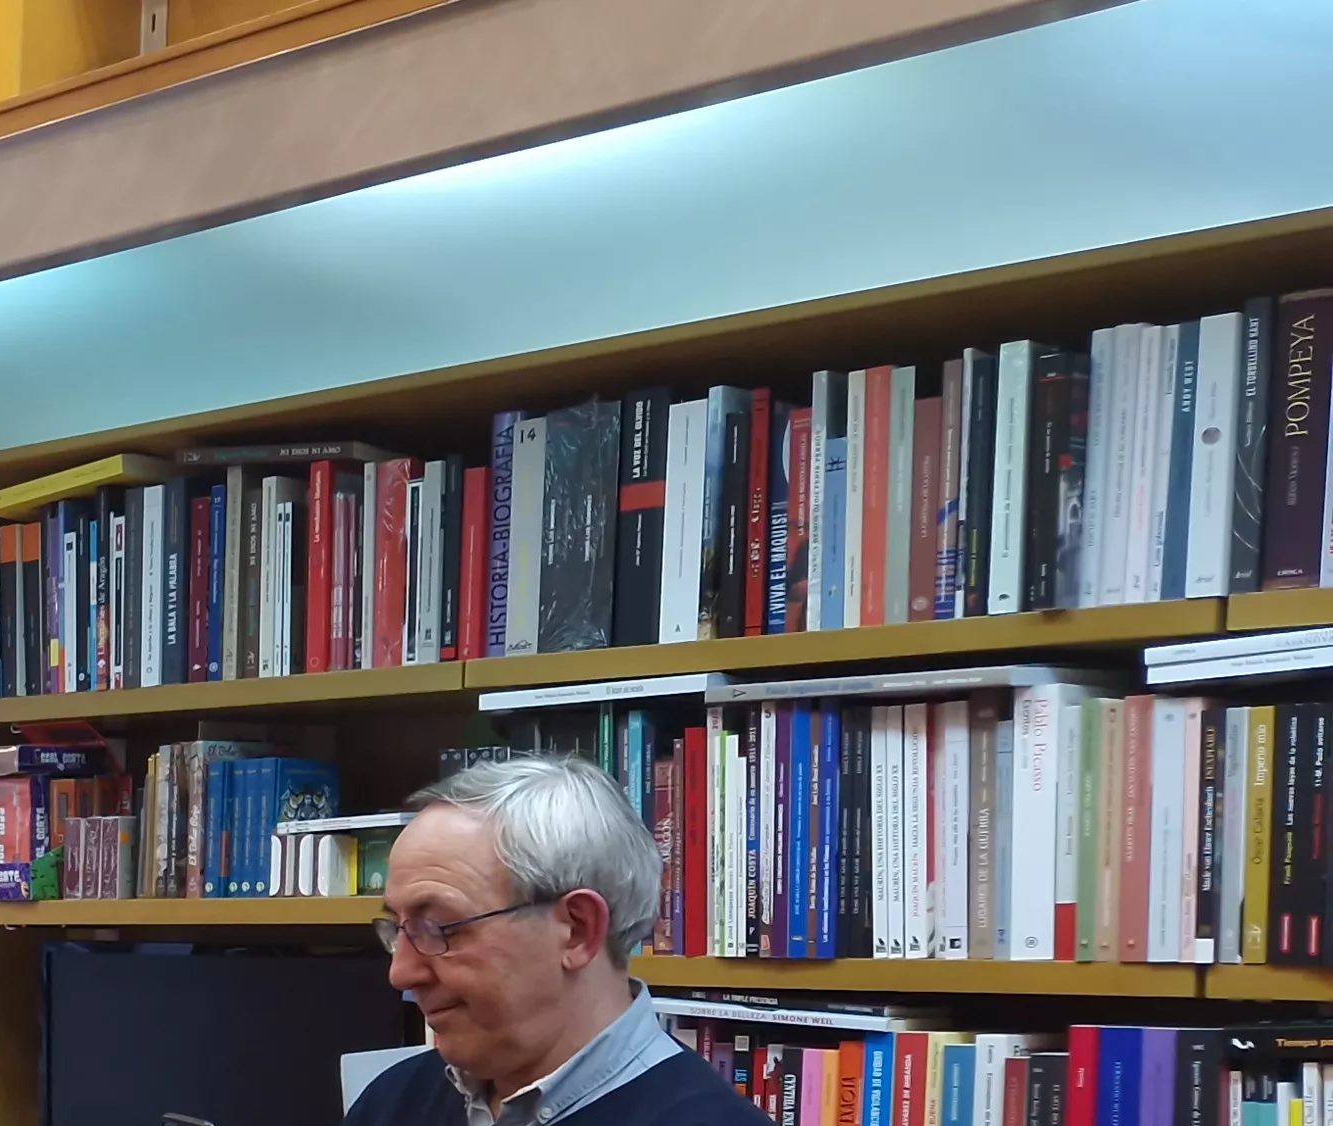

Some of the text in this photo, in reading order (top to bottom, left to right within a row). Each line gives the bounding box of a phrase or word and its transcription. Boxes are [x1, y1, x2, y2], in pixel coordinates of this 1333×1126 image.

[1249, 317, 1259, 336] KANT
[1246, 339, 1259, 384] TORBELLINO
[1284, 313, 1315, 436] POMPEYA
[1181, 360, 1194, 412] ANDY WEST
[634, 401, 644, 430] OLVIDO
[633, 432, 643, 448] DEL
[632, 450, 642, 465] VOZ
[167, 553, 178, 589] PALABRA
[770, 513, 788, 614] ¡VIVA EL MAQUIS!
[167, 591, 177, 601] LA
[167, 611, 177, 631] BALA
[167, 633, 177, 644] LA
[1032, 698, 1048, 792] Pablo Picasso
[891, 776, 899, 798] SIGLO
[891, 799, 899, 814] DEL
[661, 818, 672, 864] ARAGÓN
[891, 816, 899, 850] HISTORIA
[891, 852, 899, 868] UNA
[978, 808, 989, 927] LUGARES DE LA GUERRA
[746, 849, 756, 919] JOAQUÍN COSTA
[690, 1006, 717, 1016] SOBRE
[732, 1009, 766, 1020] BELLEZA
[772, 1013, 808, 1024] SIMONE
[812, 1016, 834, 1026] WEIL
[902, 1054, 912, 1088] MIRANDA
[782, 1074, 796, 1111] CYNTHIA
